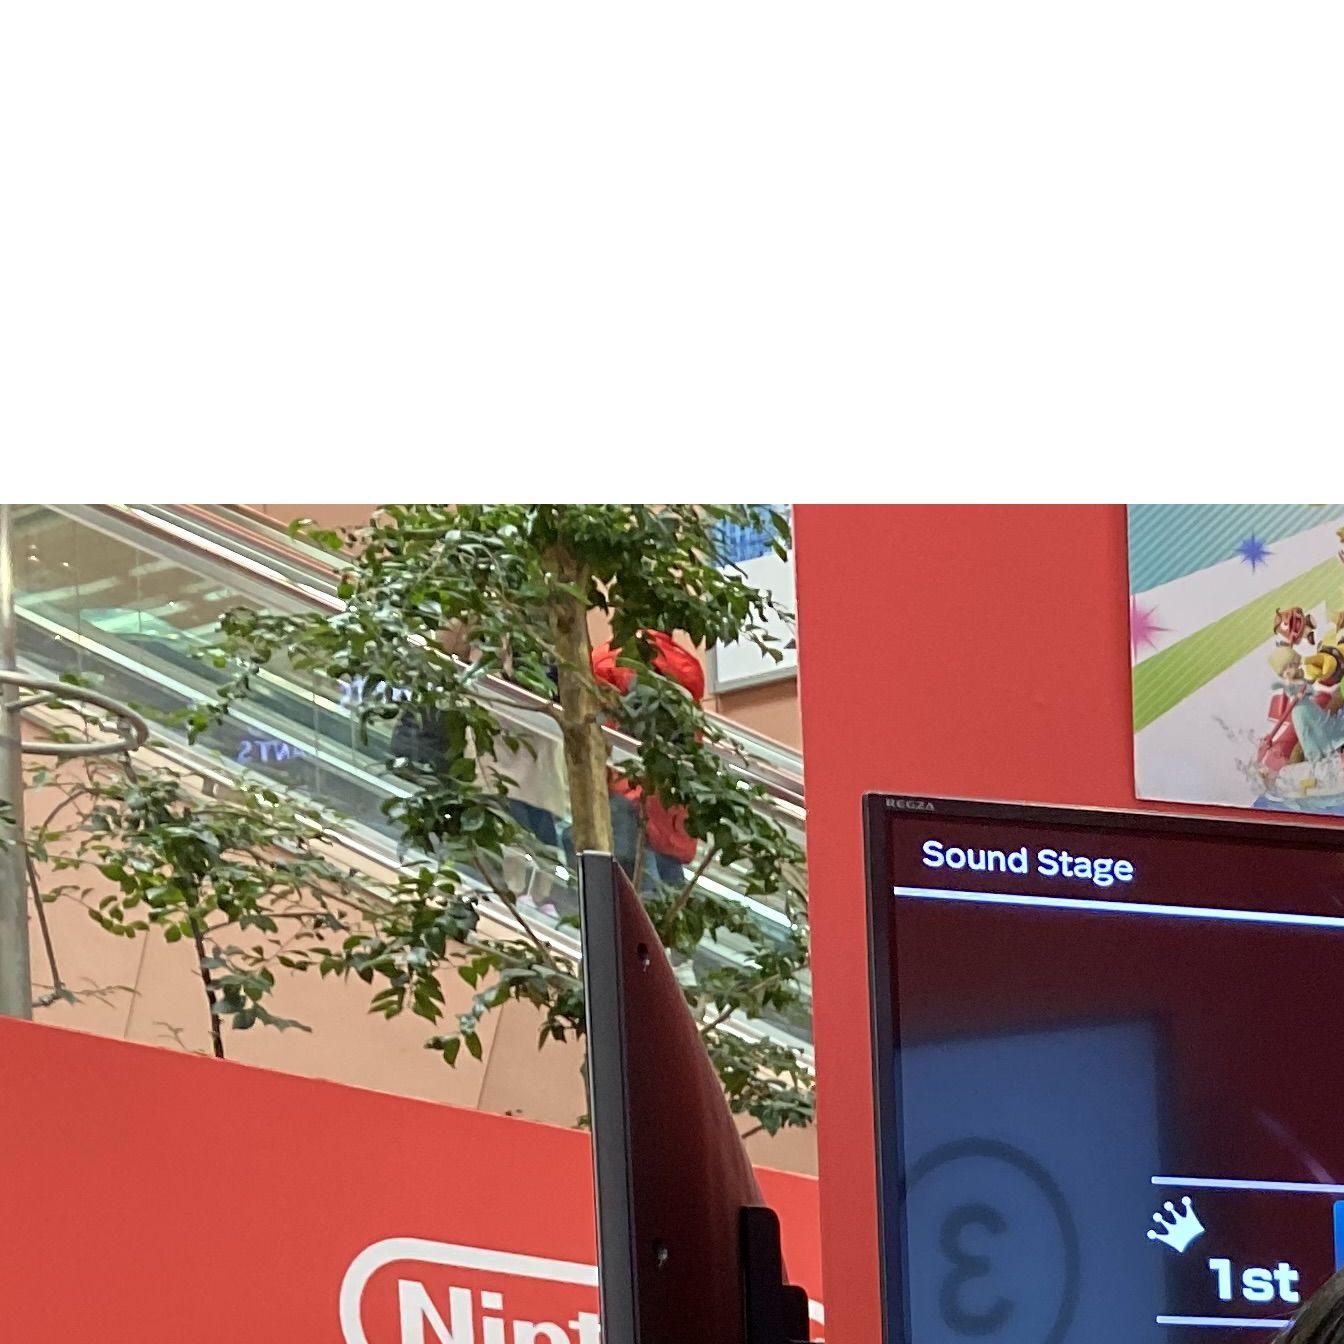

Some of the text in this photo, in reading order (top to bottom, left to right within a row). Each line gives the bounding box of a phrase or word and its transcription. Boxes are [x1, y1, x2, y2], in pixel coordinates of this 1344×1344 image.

[922, 840, 1134, 887] Sound Stage
[1208, 1257, 1300, 1303] 1st
